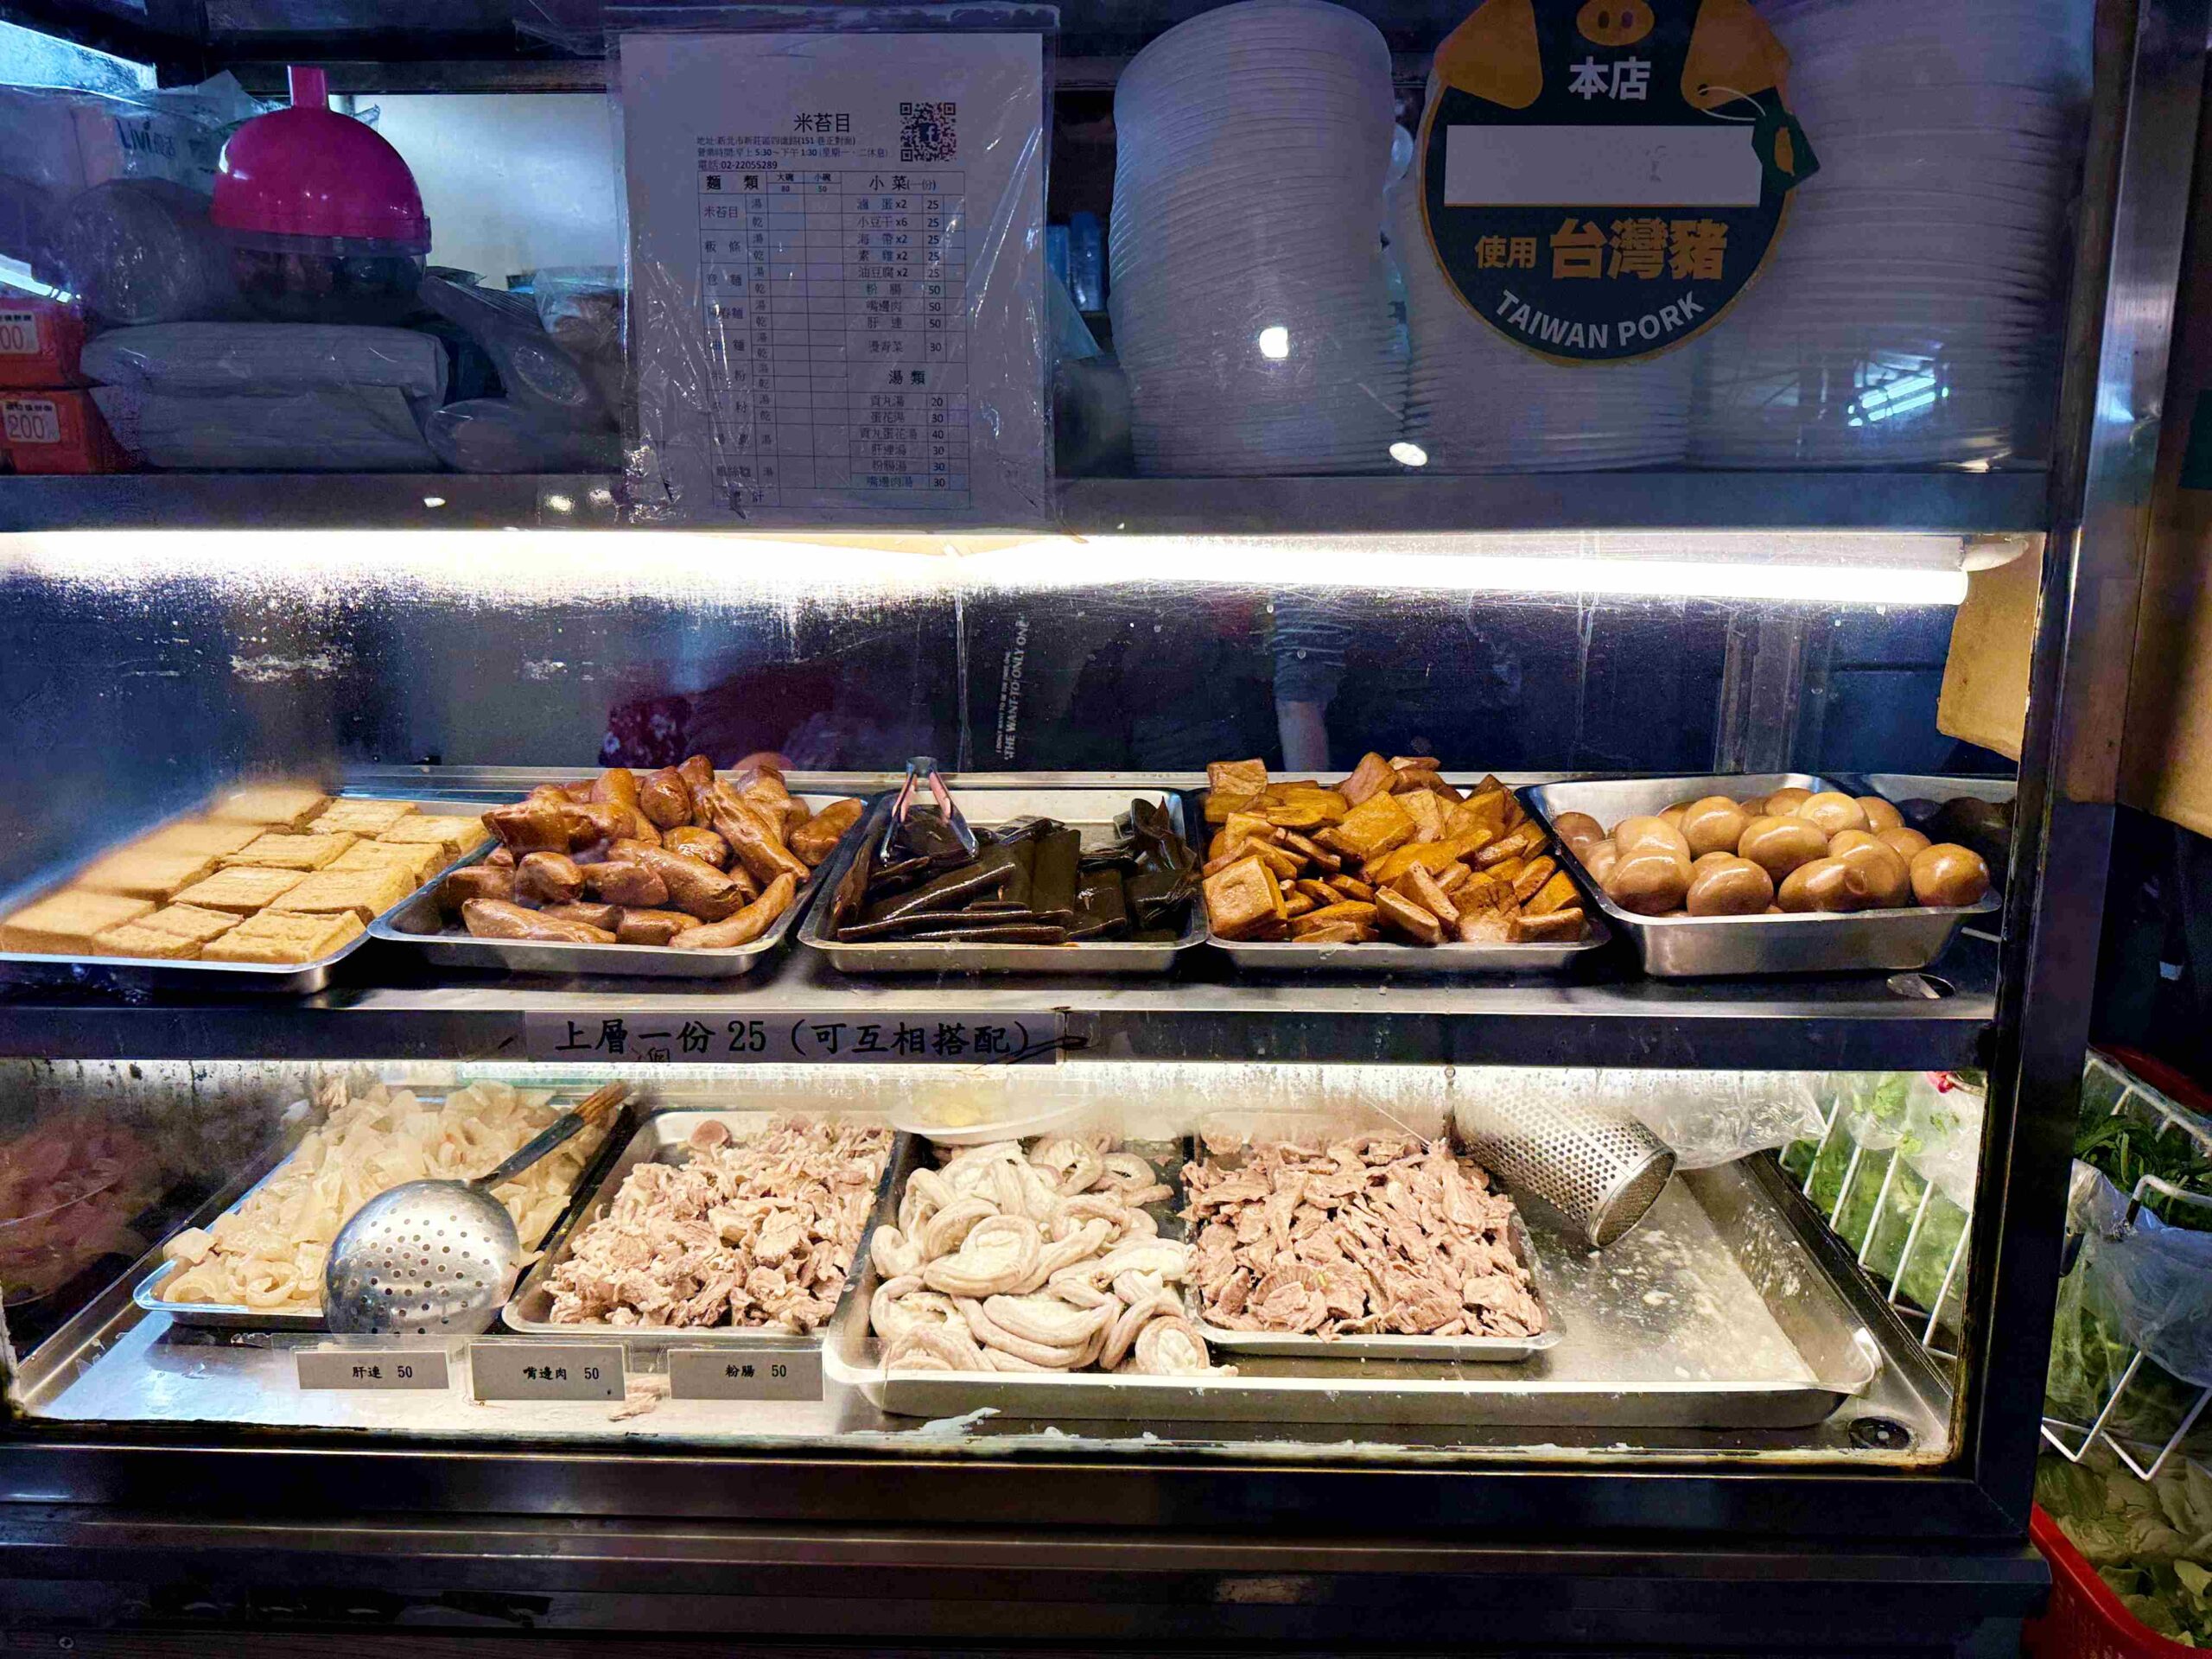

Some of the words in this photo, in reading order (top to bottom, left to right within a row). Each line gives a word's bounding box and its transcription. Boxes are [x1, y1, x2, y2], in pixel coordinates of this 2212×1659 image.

[1568, 56, 1651, 101] 本店
[793, 112, 850, 133] 米苔目
[927, 200, 939, 210] 25
[703, 206, 738, 219] 米苔目
[927, 218, 939, 227] 25
[927, 234, 939, 245] 25
[1475, 236, 1537, 270] 使用
[1549, 218, 1727, 281] 台灣豬
[928, 251, 940, 261] 25
[928, 269, 940, 278] 25
[929, 285, 941, 295] 50
[929, 302, 941, 312] 50
[929, 319, 941, 328] 50
[1494, 289, 1609, 349] TAIWAN
[1618, 290, 1706, 346] PORK
[930, 342, 942, 352] 30
[931, 397, 944, 407] 20
[931, 413, 944, 423] 30
[8, 415, 44, 439] 200
[931, 429, 944, 440] 40
[933, 446, 944, 455] 30
[933, 461, 945, 472] 30
[934, 478, 945, 488] 30
[1011, 647, 1025, 678] ONLY
[555, 1019, 716, 1054] 上層一份
[728, 1020, 766, 1052] 25
[352, 1365, 383, 1379] 肝連
[397, 1365, 413, 1379] 50
[523, 1367, 568, 1381] 嘴邊肉
[584, 1366, 600, 1380] 50
[725, 1364, 756, 1378] 粉腸
[771, 1363, 787, 1380] 50
